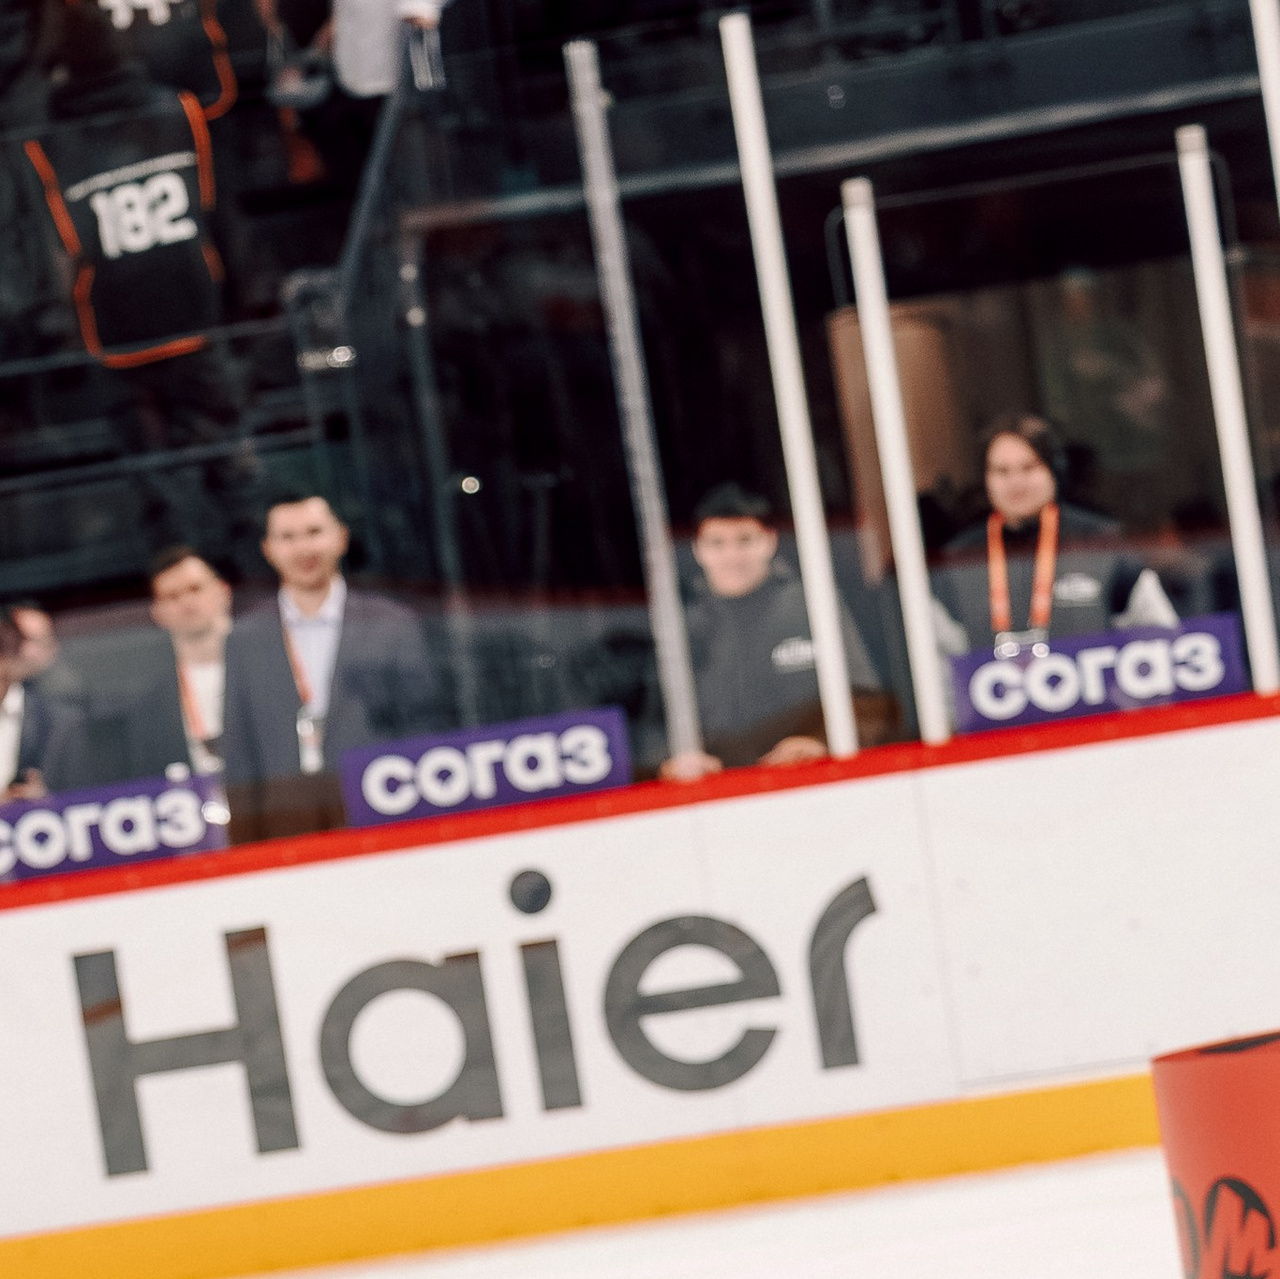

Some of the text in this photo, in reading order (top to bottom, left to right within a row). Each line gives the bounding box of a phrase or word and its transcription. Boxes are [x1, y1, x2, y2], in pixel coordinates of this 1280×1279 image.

[89, 171, 199, 259] 182
[970, 631, 1226, 721] согаз
[361, 724, 613, 816] согаз
[72, 869, 879, 1178] Haier
